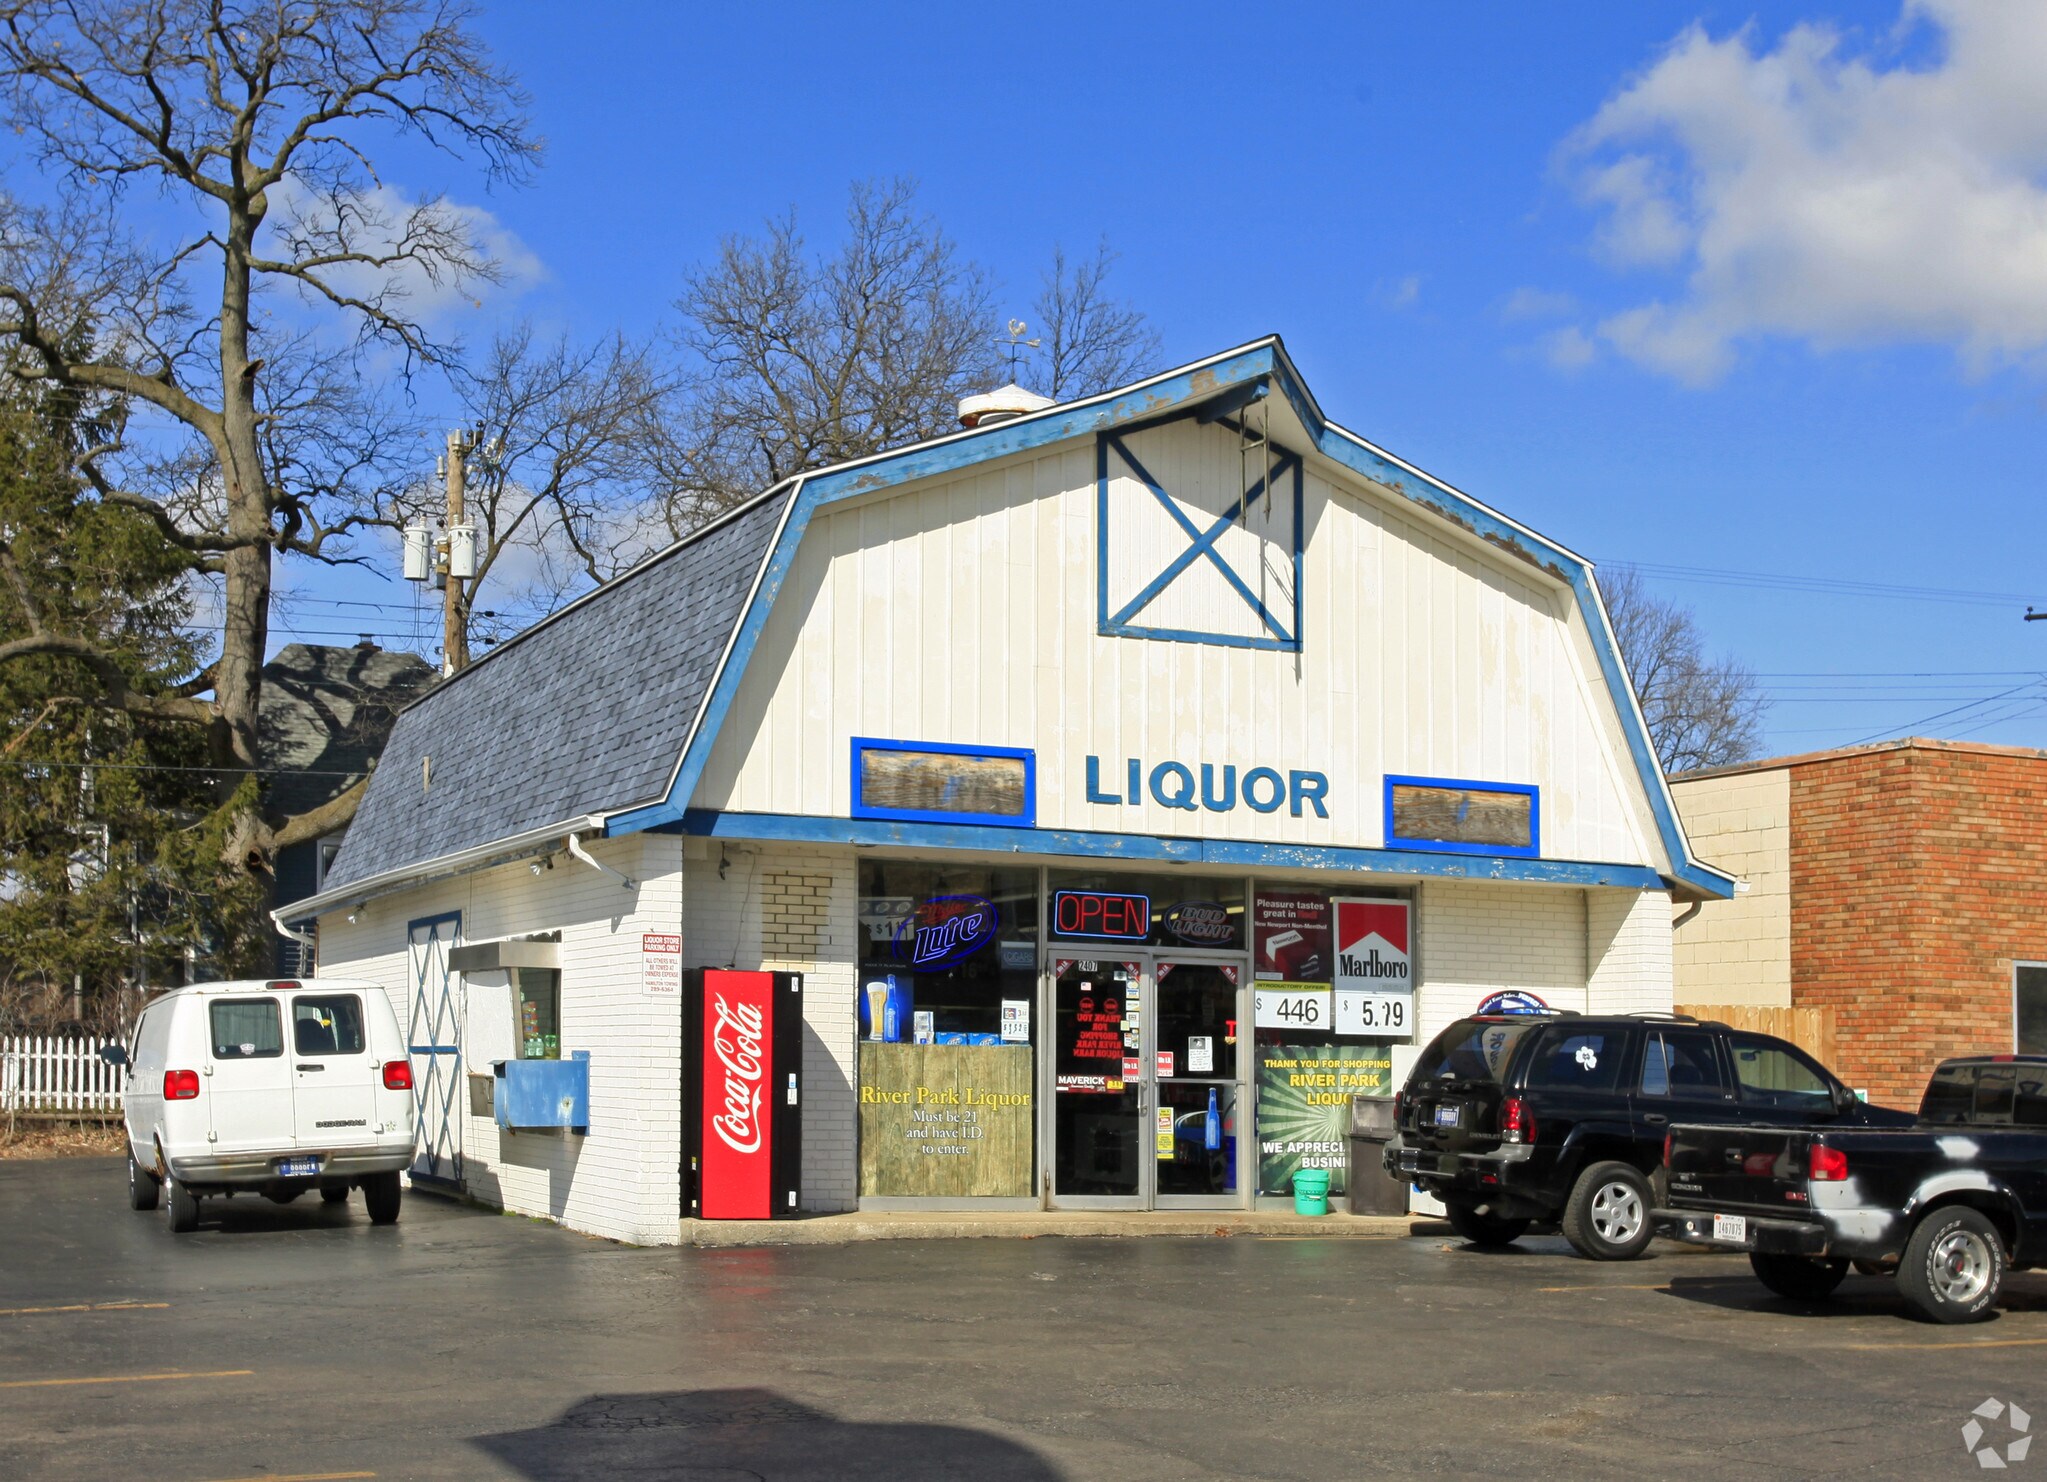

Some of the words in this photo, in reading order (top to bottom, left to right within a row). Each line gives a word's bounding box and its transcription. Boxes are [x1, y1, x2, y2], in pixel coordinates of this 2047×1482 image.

[1086, 755, 1329, 819] LIQUOR
[1257, 899, 1295, 909] Pleasure
[1297, 900, 1325, 911] tastes
[1058, 895, 1146, 935] OPEN
[1180, 906, 1227, 924] BUD
[1263, 910, 1287, 919] great
[1170, 920, 1235, 939] LIGHT
[1267, 921, 1291, 929] Newport
[644, 936, 663, 944] LIQUOR
[663, 937, 680, 945] STORE
[913, 913, 983, 964] Lite
[666, 944, 680, 952] ONLY
[1078, 960, 1098, 972] 2407
[1339, 949, 1407, 979] Marlboro
[1255, 998, 1262, 1011] $
[1277, 998, 1319, 1022] 446
[1343, 1000, 1349, 1012] $
[1264, 1059, 1298, 1068] THANK
[1300, 1059, 1319, 1068] YOU
[1322, 1059, 1341, 1068] FOR
[1343, 1060, 1391, 1069] SHOPPING
[713, 991, 763, 1154] Coca-Cola
[1058, 1076, 1105, 1085] MAVERICK
[1289, 1074, 1337, 1087] RIVER
[1340, 1074, 1380, 1087] PARK
[860, 1086, 911, 1104] River
[916, 1087, 960, 1105] Park
[966, 1087, 1030, 1111] Liquor
[912, 1110, 943, 1123] Must
[946, 1110, 960, 1123] be
[963, 1111, 978, 1123] 21
[316, 1120, 347, 1128] DODGE
[348, 1119, 367, 1127] RAM
[906, 1126, 928, 1139] and
[932, 1127, 959, 1139] have
[961, 1127, 984, 1139] I.D.
[922, 1144, 934, 1154] to
[937, 1145, 969, 1154] enter.
[1262, 1142, 1283, 1153] WE
